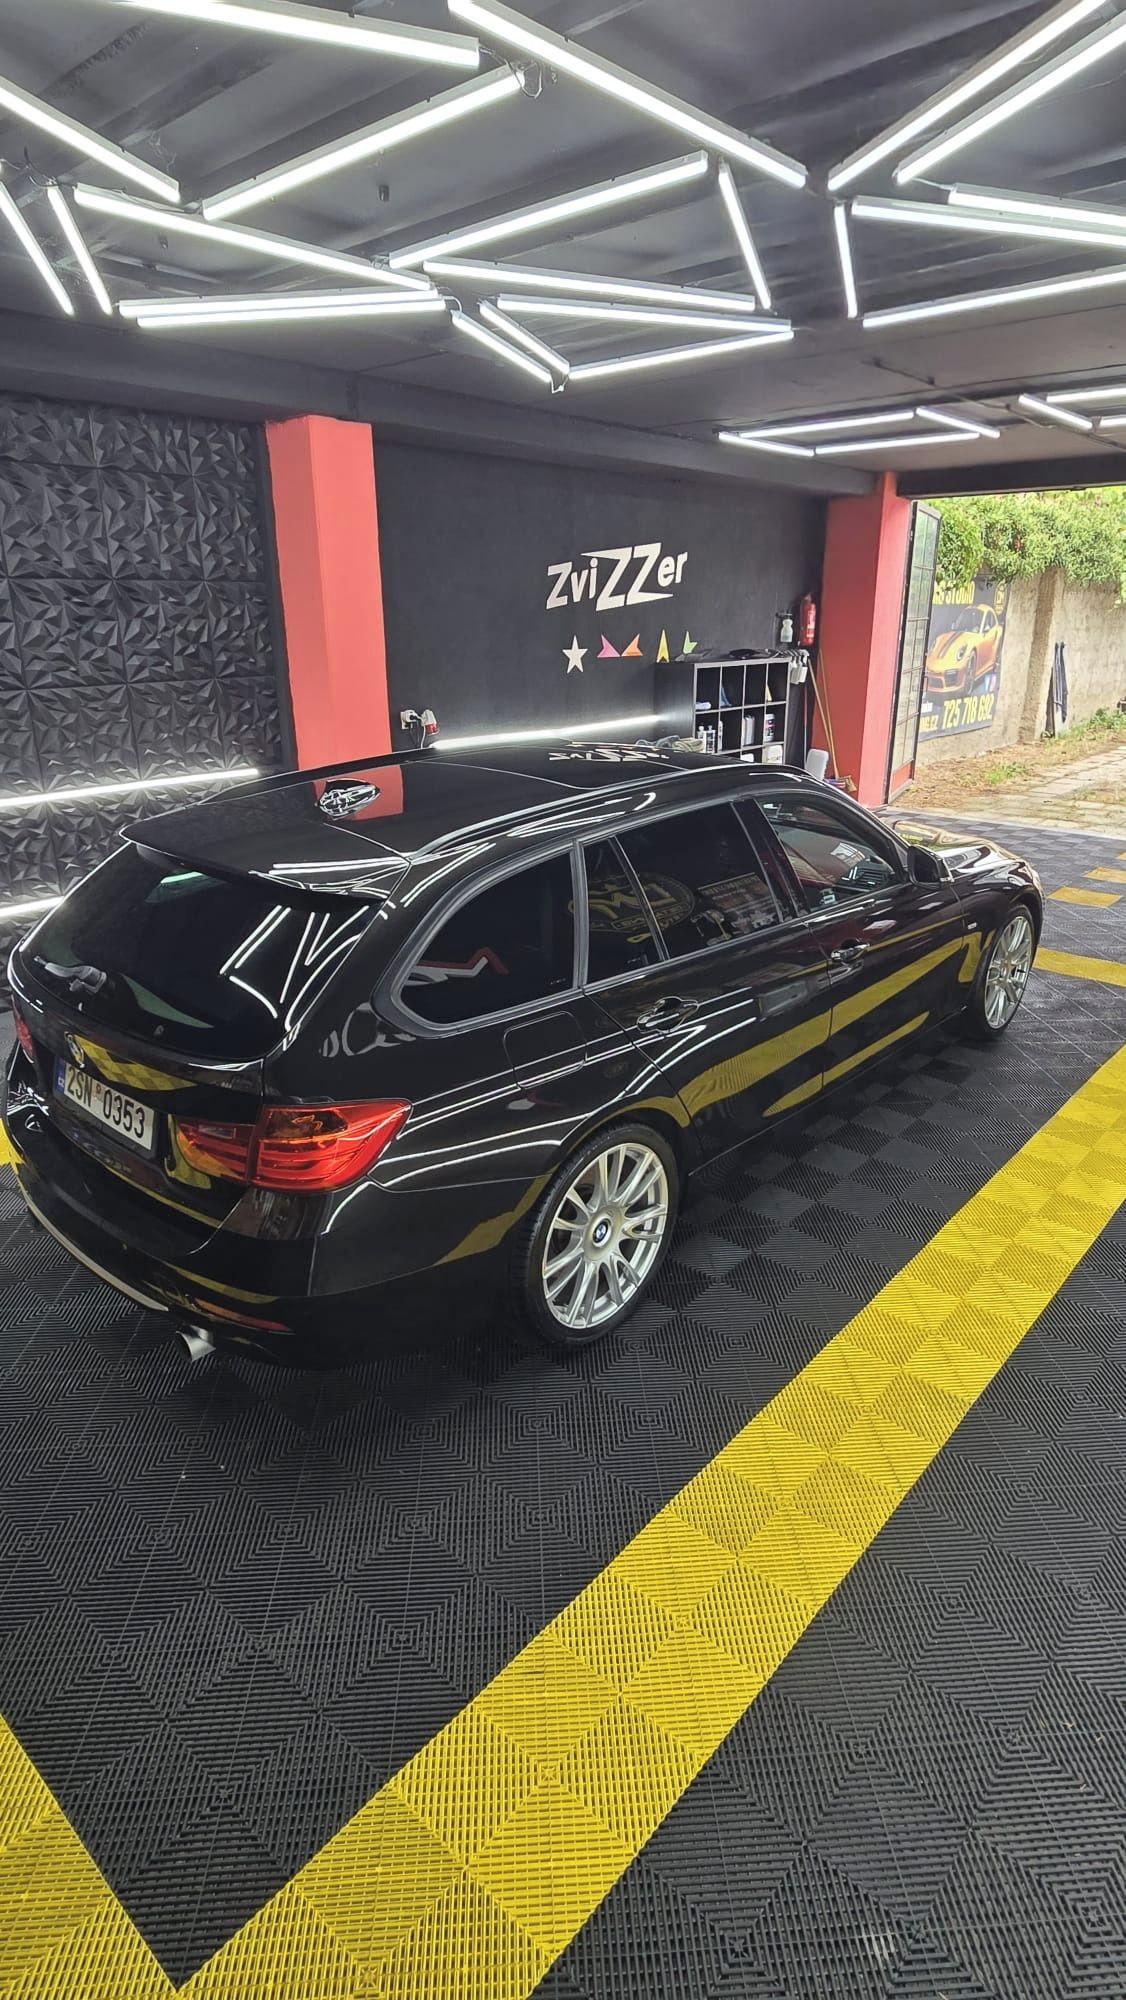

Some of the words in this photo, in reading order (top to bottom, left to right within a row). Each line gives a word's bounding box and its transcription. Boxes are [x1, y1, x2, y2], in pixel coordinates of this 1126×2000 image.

[942, 699, 962, 730] 725
[962, 695, 978, 725] 718
[67, 1066, 93, 1108] 2SN
[103, 1089, 145, 1139] 0353
